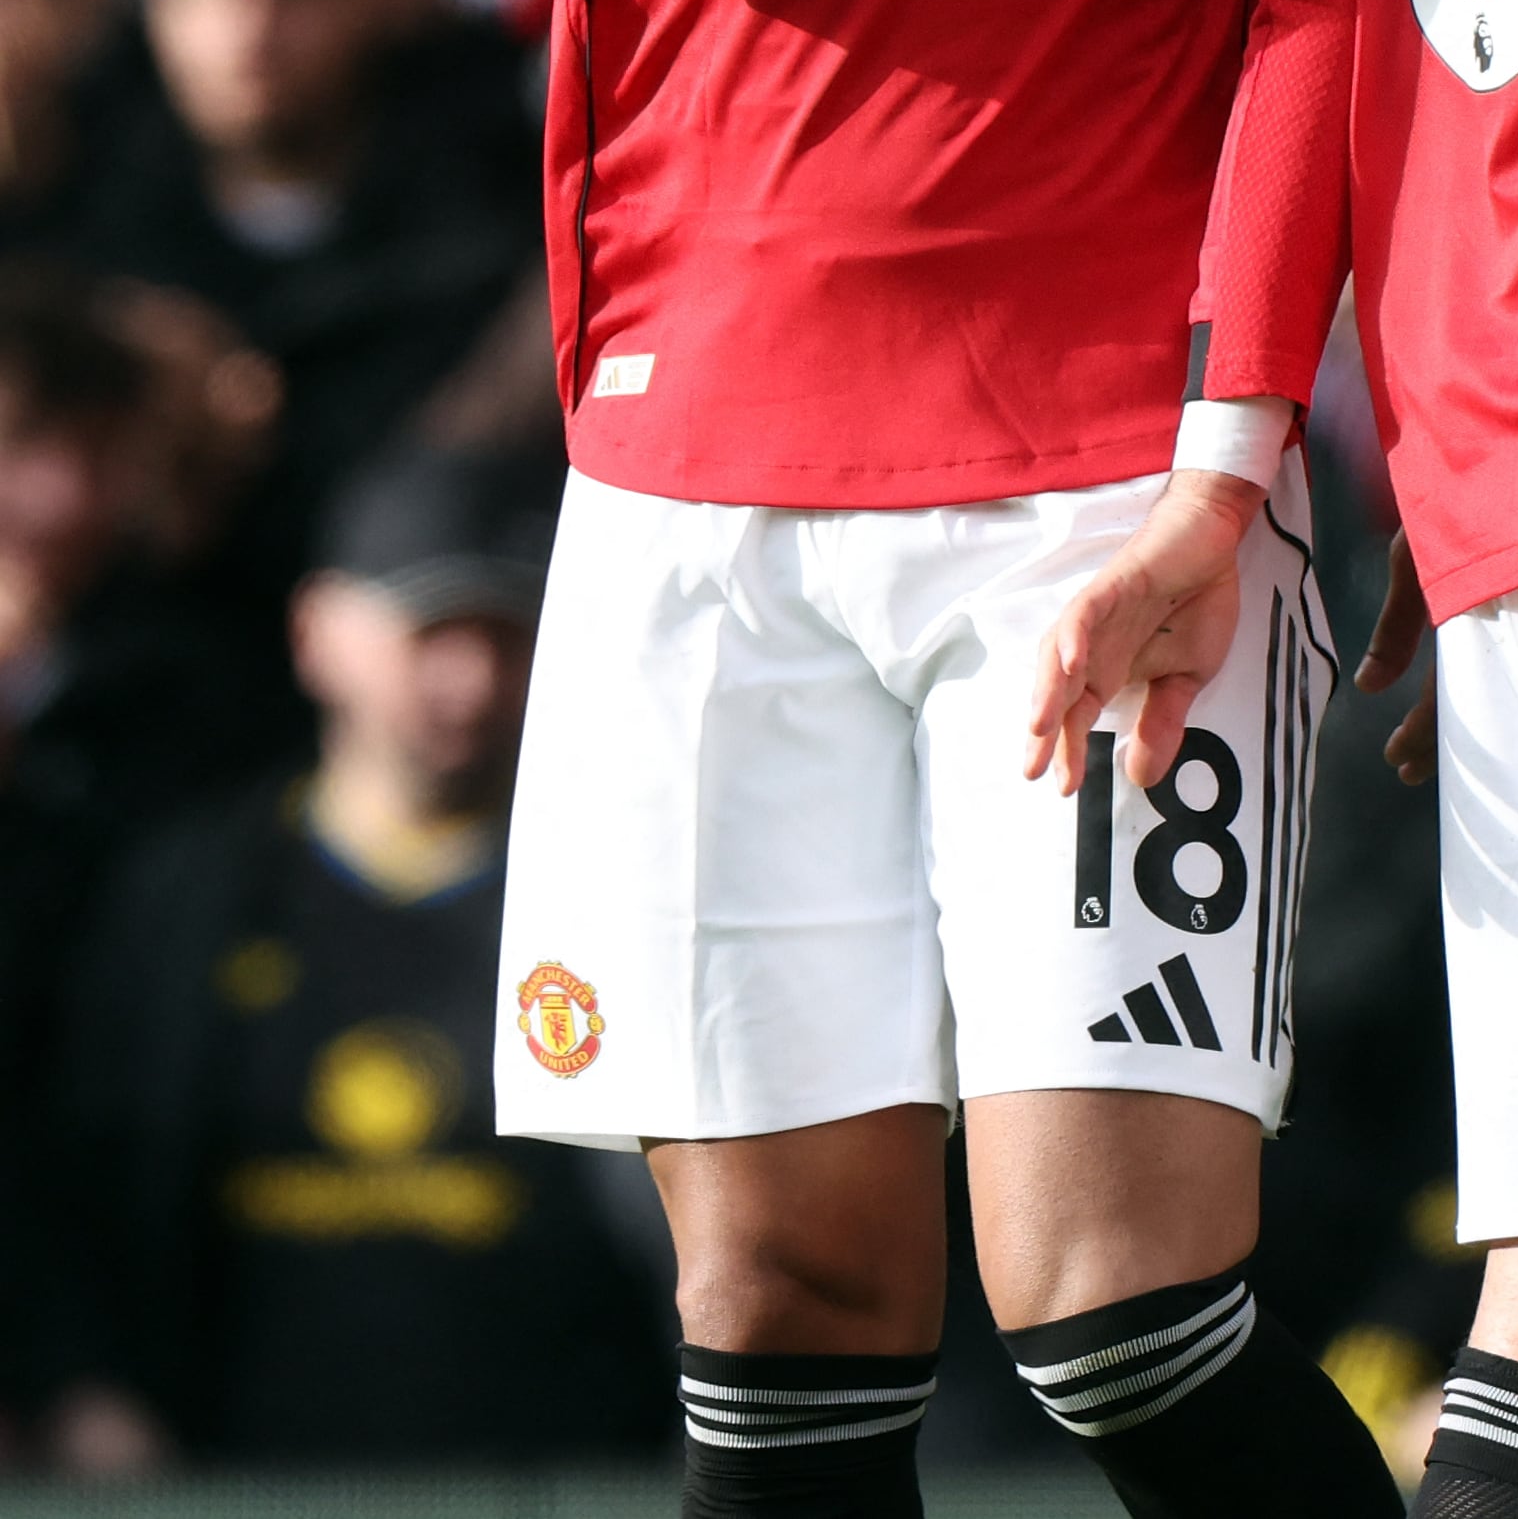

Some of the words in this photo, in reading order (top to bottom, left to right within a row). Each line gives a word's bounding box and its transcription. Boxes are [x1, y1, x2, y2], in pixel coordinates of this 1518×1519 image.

[1073, 725, 1248, 935] 18
[523, 968, 591, 1007] MANCHESTER
[539, 1050, 589, 1071] UNITED
